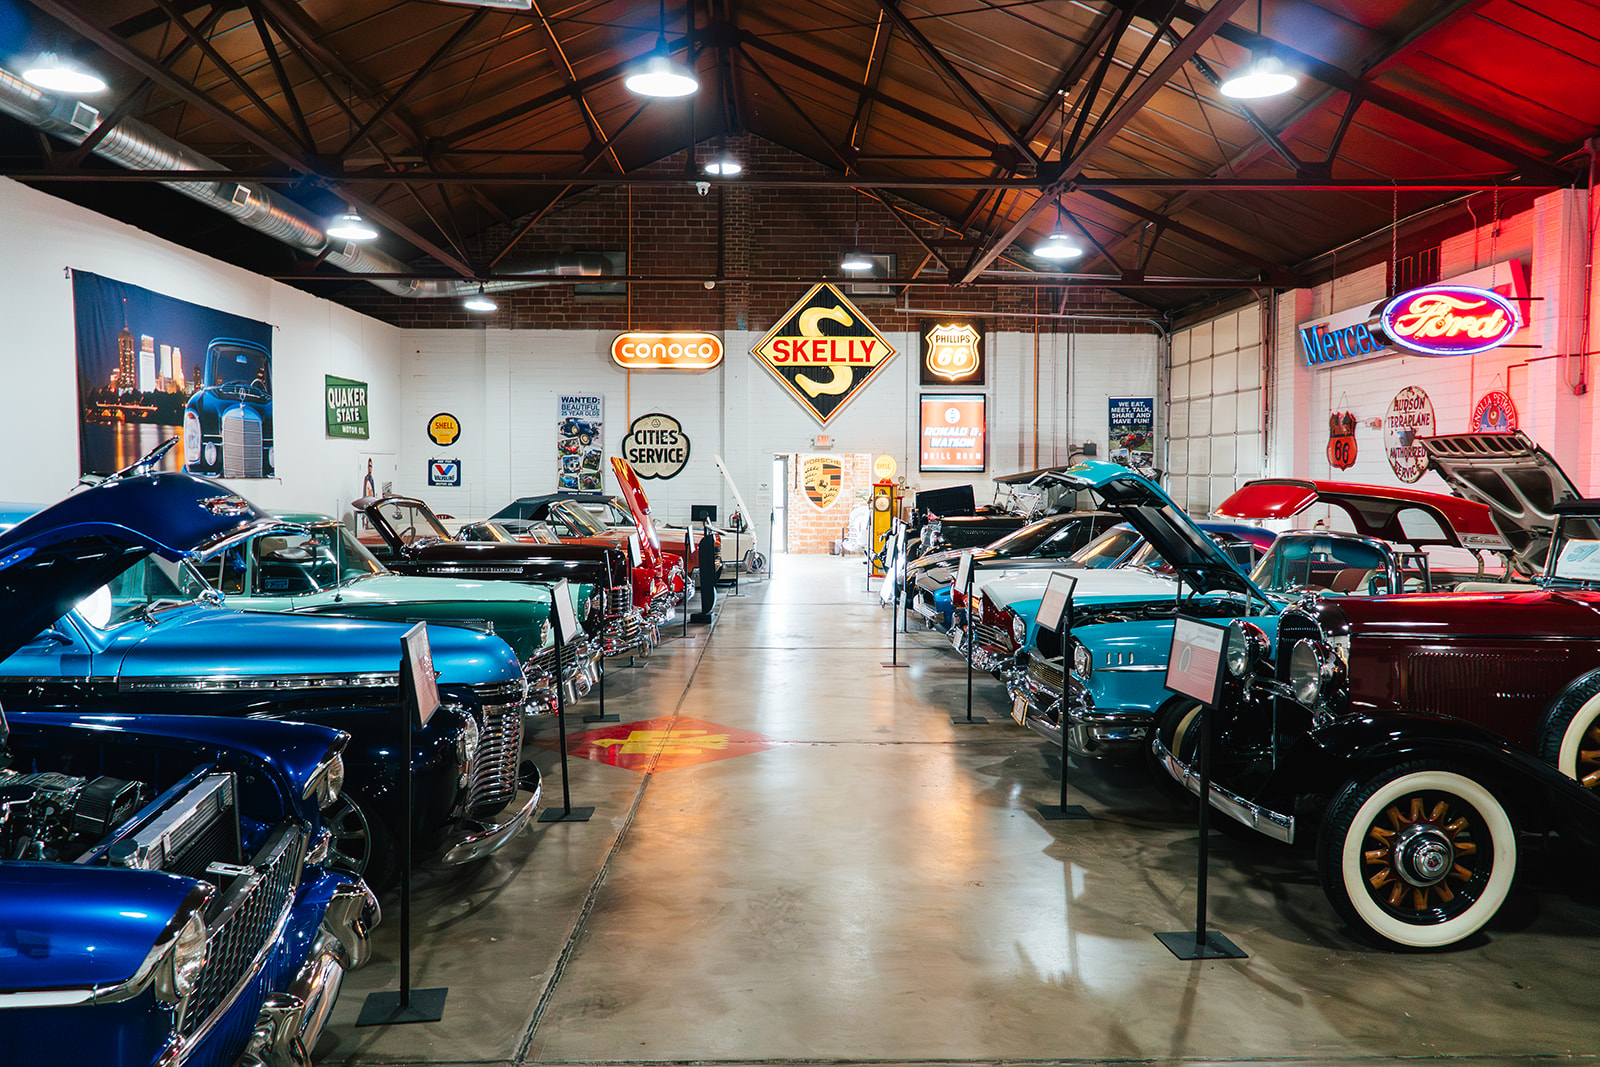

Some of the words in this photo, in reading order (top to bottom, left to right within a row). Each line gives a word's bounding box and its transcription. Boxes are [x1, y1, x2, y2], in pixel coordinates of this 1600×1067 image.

[1394, 294, 1507, 338] Ford
[935, 334, 971, 344] PHILLIPS
[772, 339, 876, 363] SKELLY
[937, 347, 969, 366] 66
[328, 387, 366, 409] QUAKER
[561, 396, 601, 404] WANTED:
[1393, 396, 1426, 412] HUDSON
[336, 407, 360, 423] STATE
[1387, 412, 1431, 429] TERRAPLANE
[342, 425, 358, 433] MOTOR
[435, 421, 454, 430] SHELL
[634, 429, 679, 445] CITIES
[929, 437, 977, 448] WATSON
[629, 448, 684, 464] SERVICE
[1334, 440, 1350, 464] 66
[803, 457, 843, 467] PORSCHE
